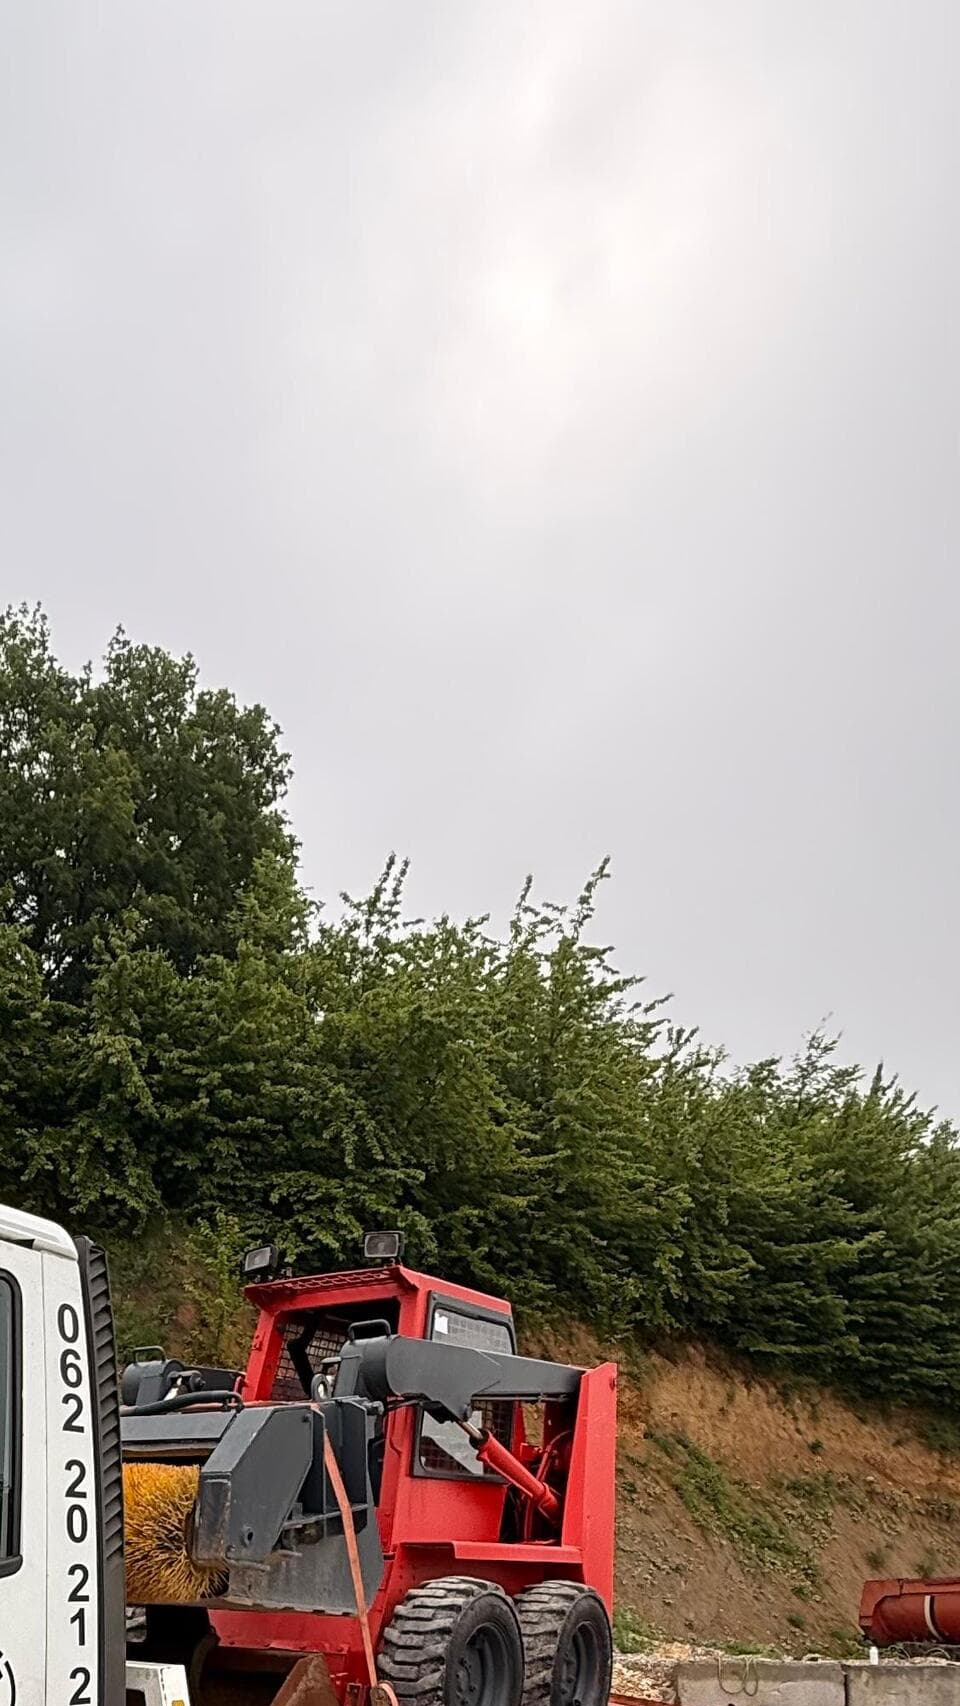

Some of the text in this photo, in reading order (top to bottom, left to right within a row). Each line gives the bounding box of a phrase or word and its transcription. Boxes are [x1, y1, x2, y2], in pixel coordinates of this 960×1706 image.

[57, 1303, 85, 1433] 062
[64, 1459, 88, 1543] 20
[67, 1563, 90, 1646] 21
